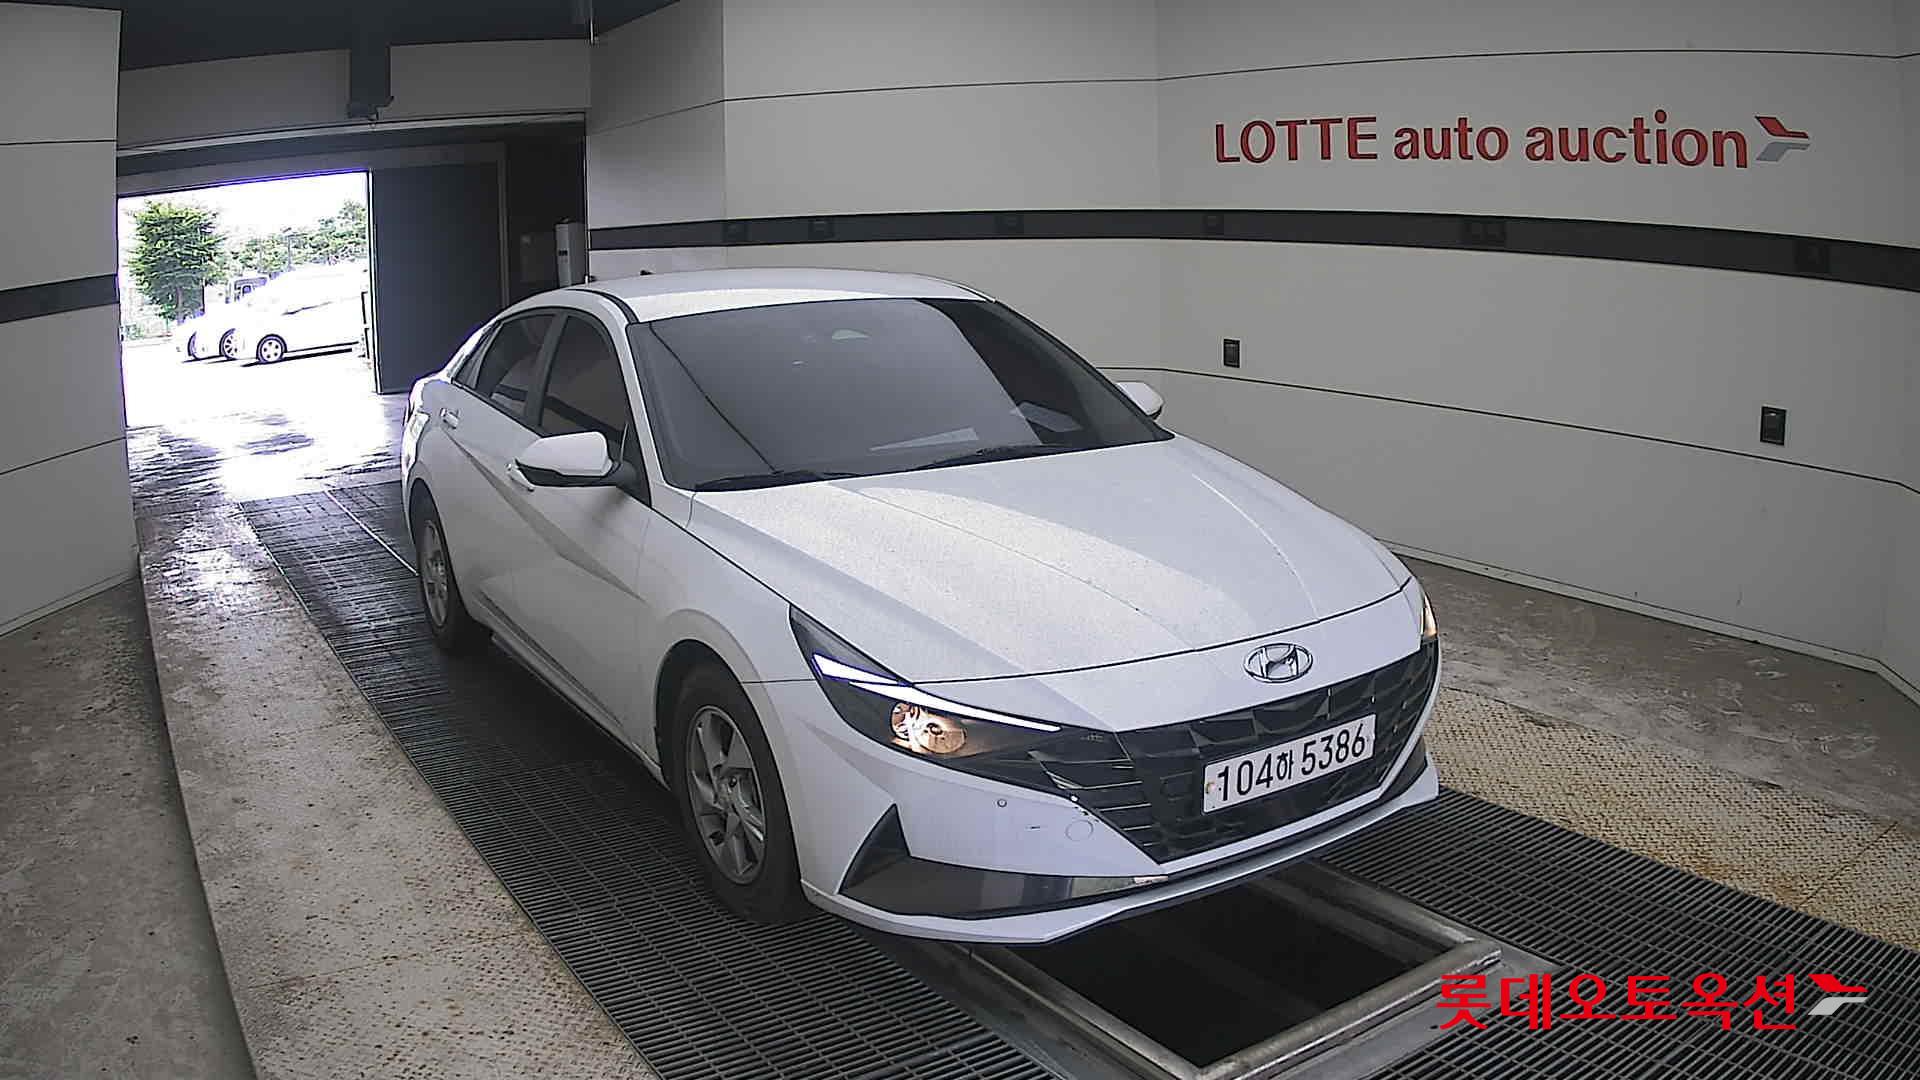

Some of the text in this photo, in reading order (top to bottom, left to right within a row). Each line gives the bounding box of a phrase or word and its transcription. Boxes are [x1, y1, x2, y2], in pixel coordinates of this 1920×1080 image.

[1214, 109, 1749, 169] LOTTE auto auction
[1217, 723, 1366, 801] 104하 5386
